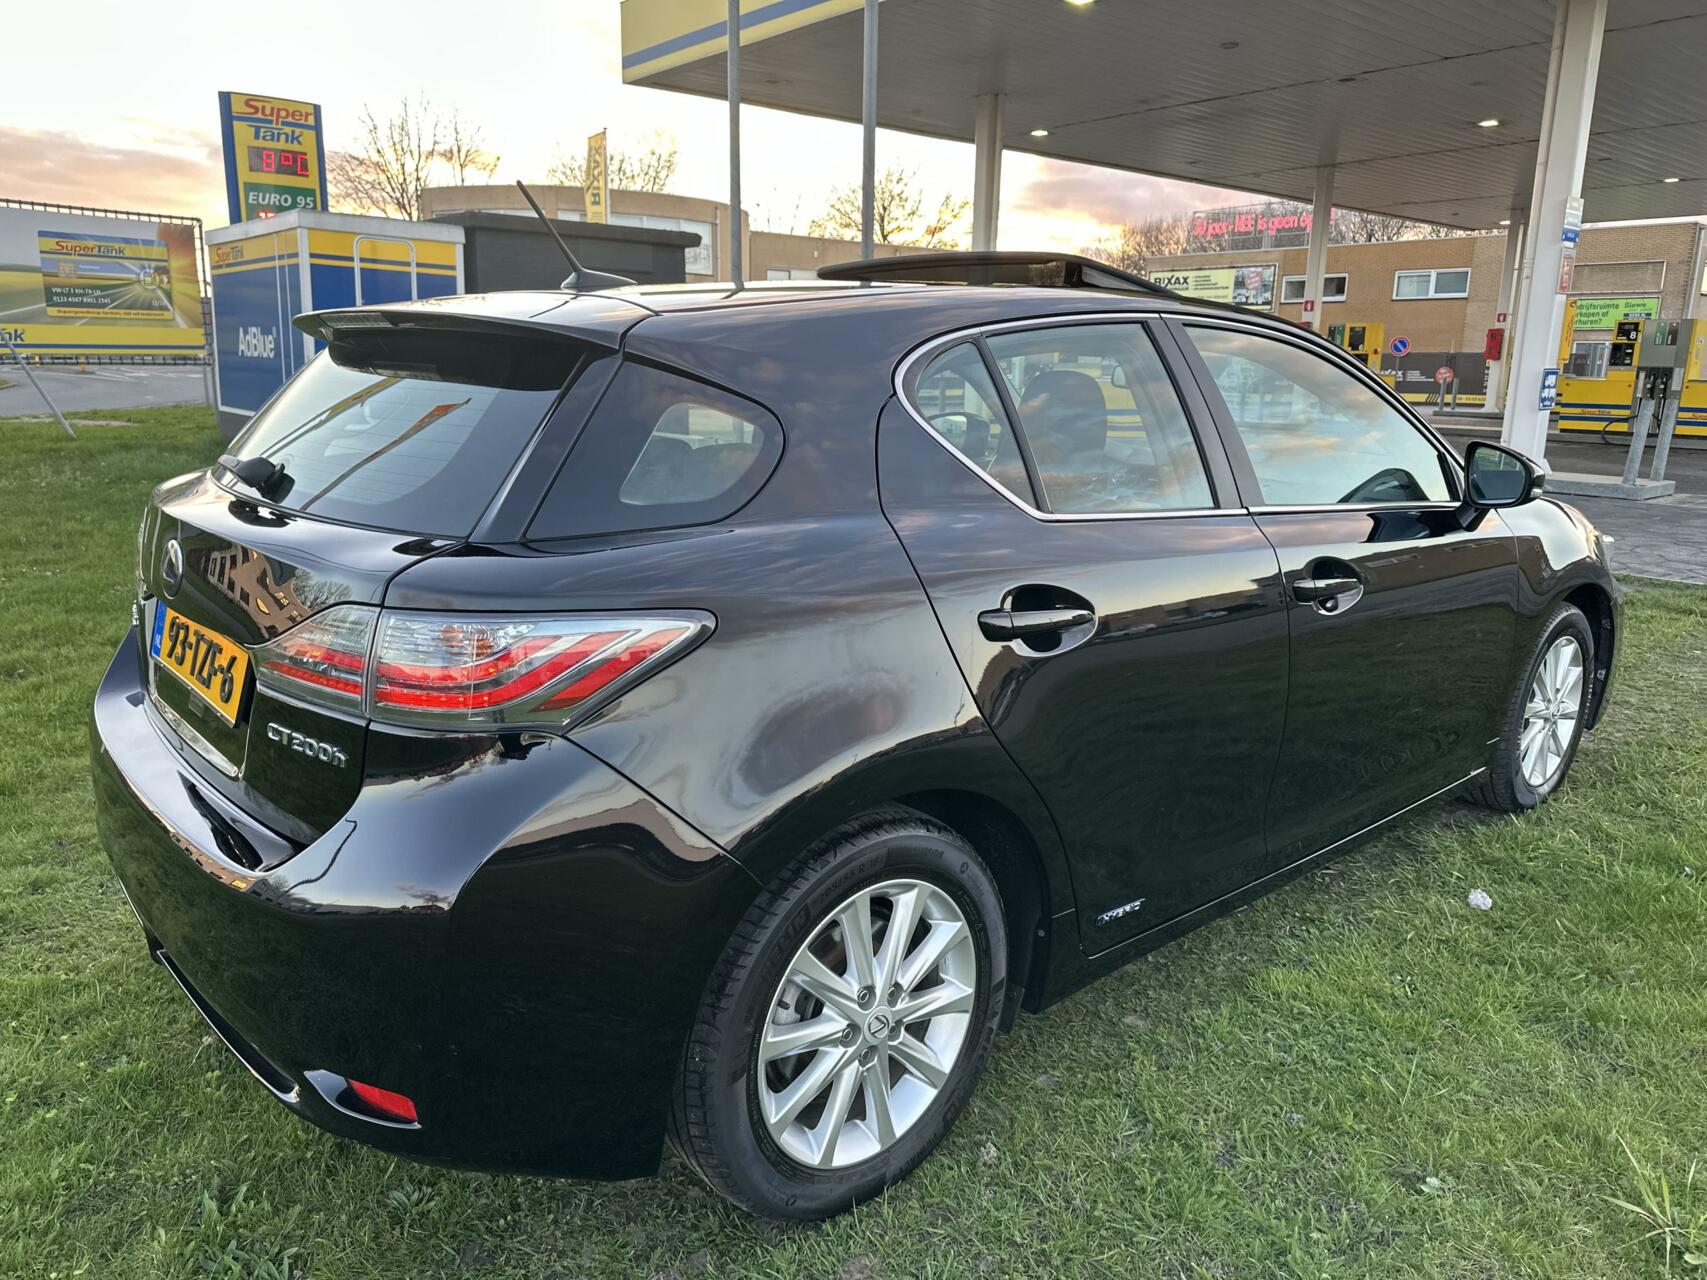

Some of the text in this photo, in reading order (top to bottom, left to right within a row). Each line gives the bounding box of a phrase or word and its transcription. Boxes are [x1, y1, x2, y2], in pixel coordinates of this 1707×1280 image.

[232, 98, 313, 127] Super
[247, 124, 303, 145] Tank
[248, 191, 315, 209] EURO 95
[50, 240, 126, 257] SuperTank
[1629, 331, 1637, 340] 8
[167, 615, 237, 704] 93-TZF-6
